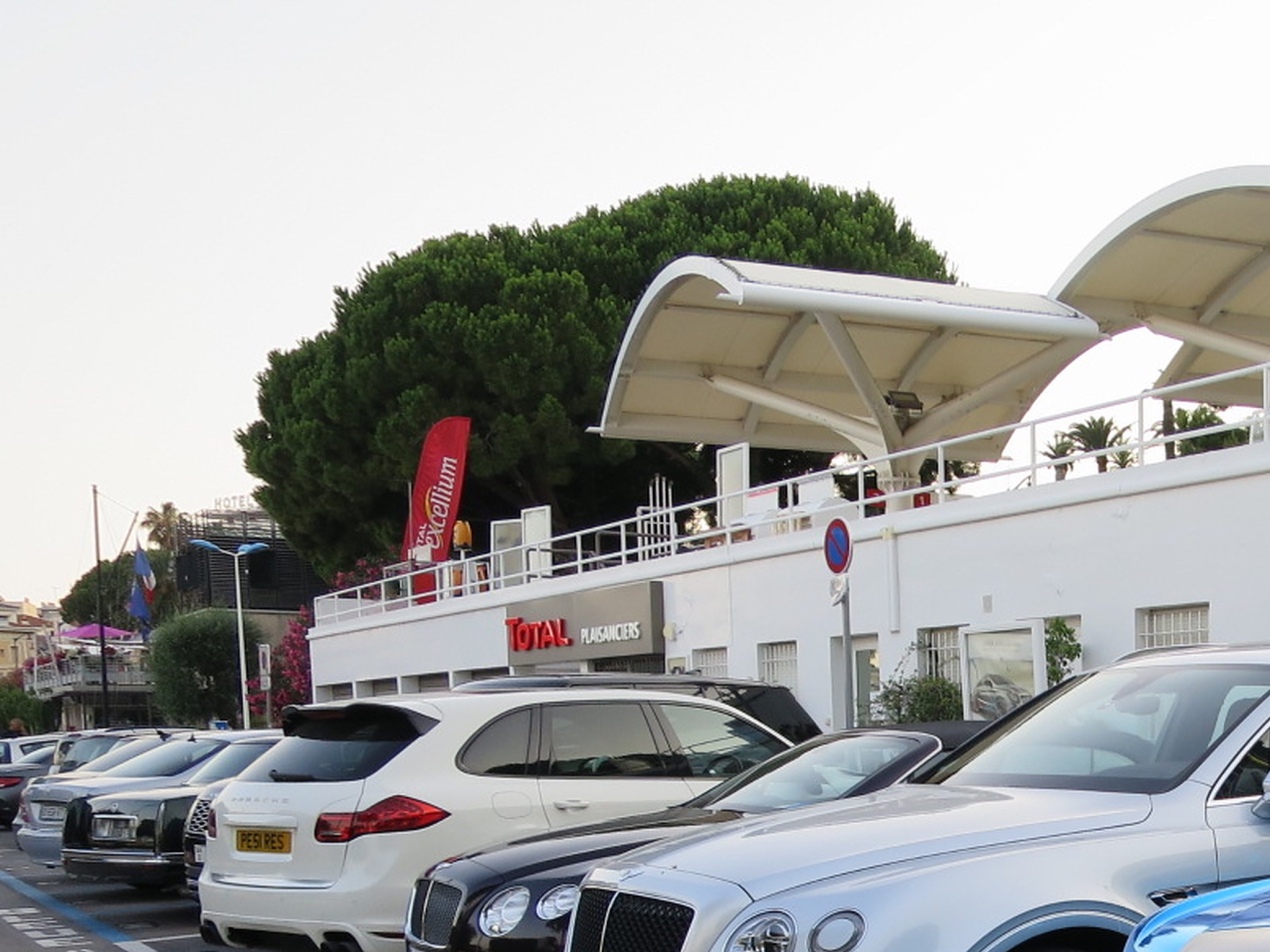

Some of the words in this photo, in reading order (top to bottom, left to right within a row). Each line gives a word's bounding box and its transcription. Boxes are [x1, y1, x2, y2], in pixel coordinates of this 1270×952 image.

[214, 496, 254, 510] HOTEL
[426, 456, 458, 549] excellium
[505, 617, 573, 651] TOTAL
[581, 622, 640, 645] PLAISANCIERS
[241, 832, 262, 850] PE51
[263, 833, 285, 850] RES
